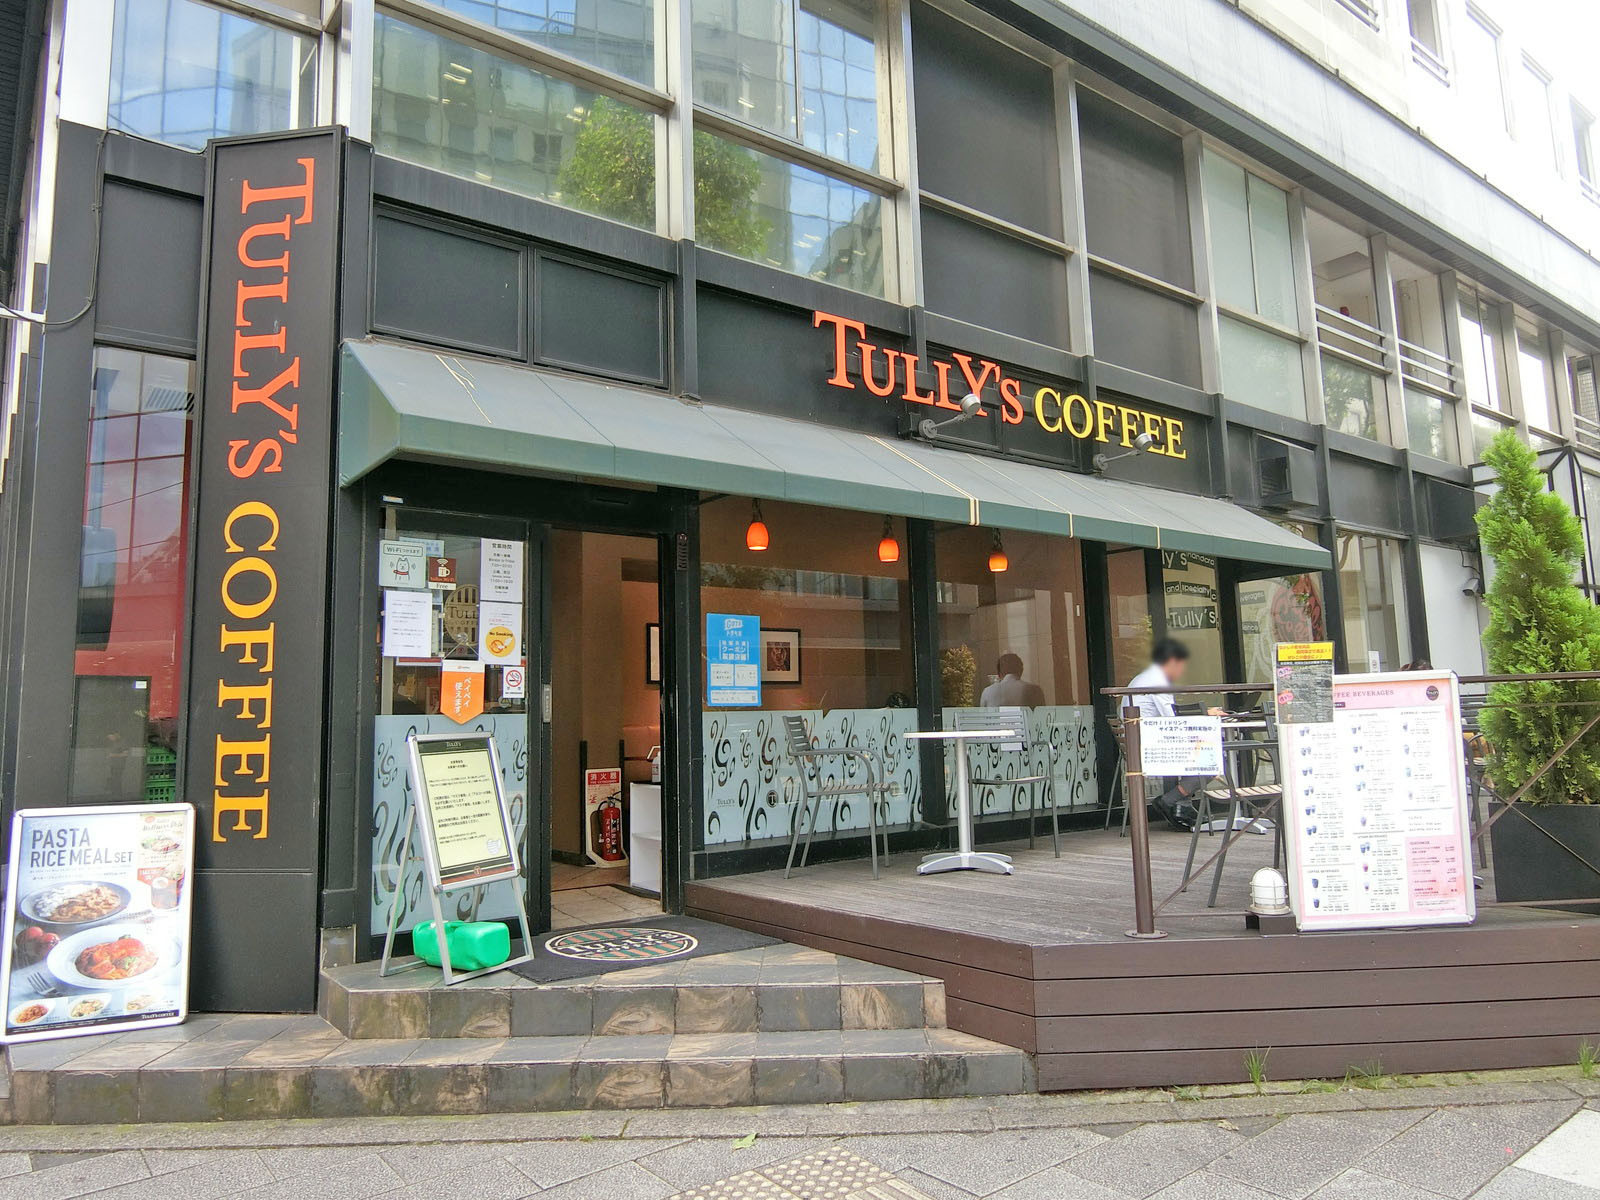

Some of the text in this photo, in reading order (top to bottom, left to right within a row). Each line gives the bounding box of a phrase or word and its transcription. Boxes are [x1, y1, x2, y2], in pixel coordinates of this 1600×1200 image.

[813, 310, 1187, 460] TULLY'S COFFEE
[211, 157, 315, 842] TULLY'S COFFEE
[1166, 584, 1180, 592] and
[1181, 584, 1210, 595] specialty
[1169, 608, 1216, 629] Tully's
[463, 677, 472, 708] ペイペイ
[1353, 689, 1394, 697] BEVERAGES
[590, 772, 617, 780] 消火器
[31, 827, 91, 850] PASTA
[30, 850, 66, 868] RICE
[69, 848, 112, 866] MEAL
[114, 851, 134, 863] SET
